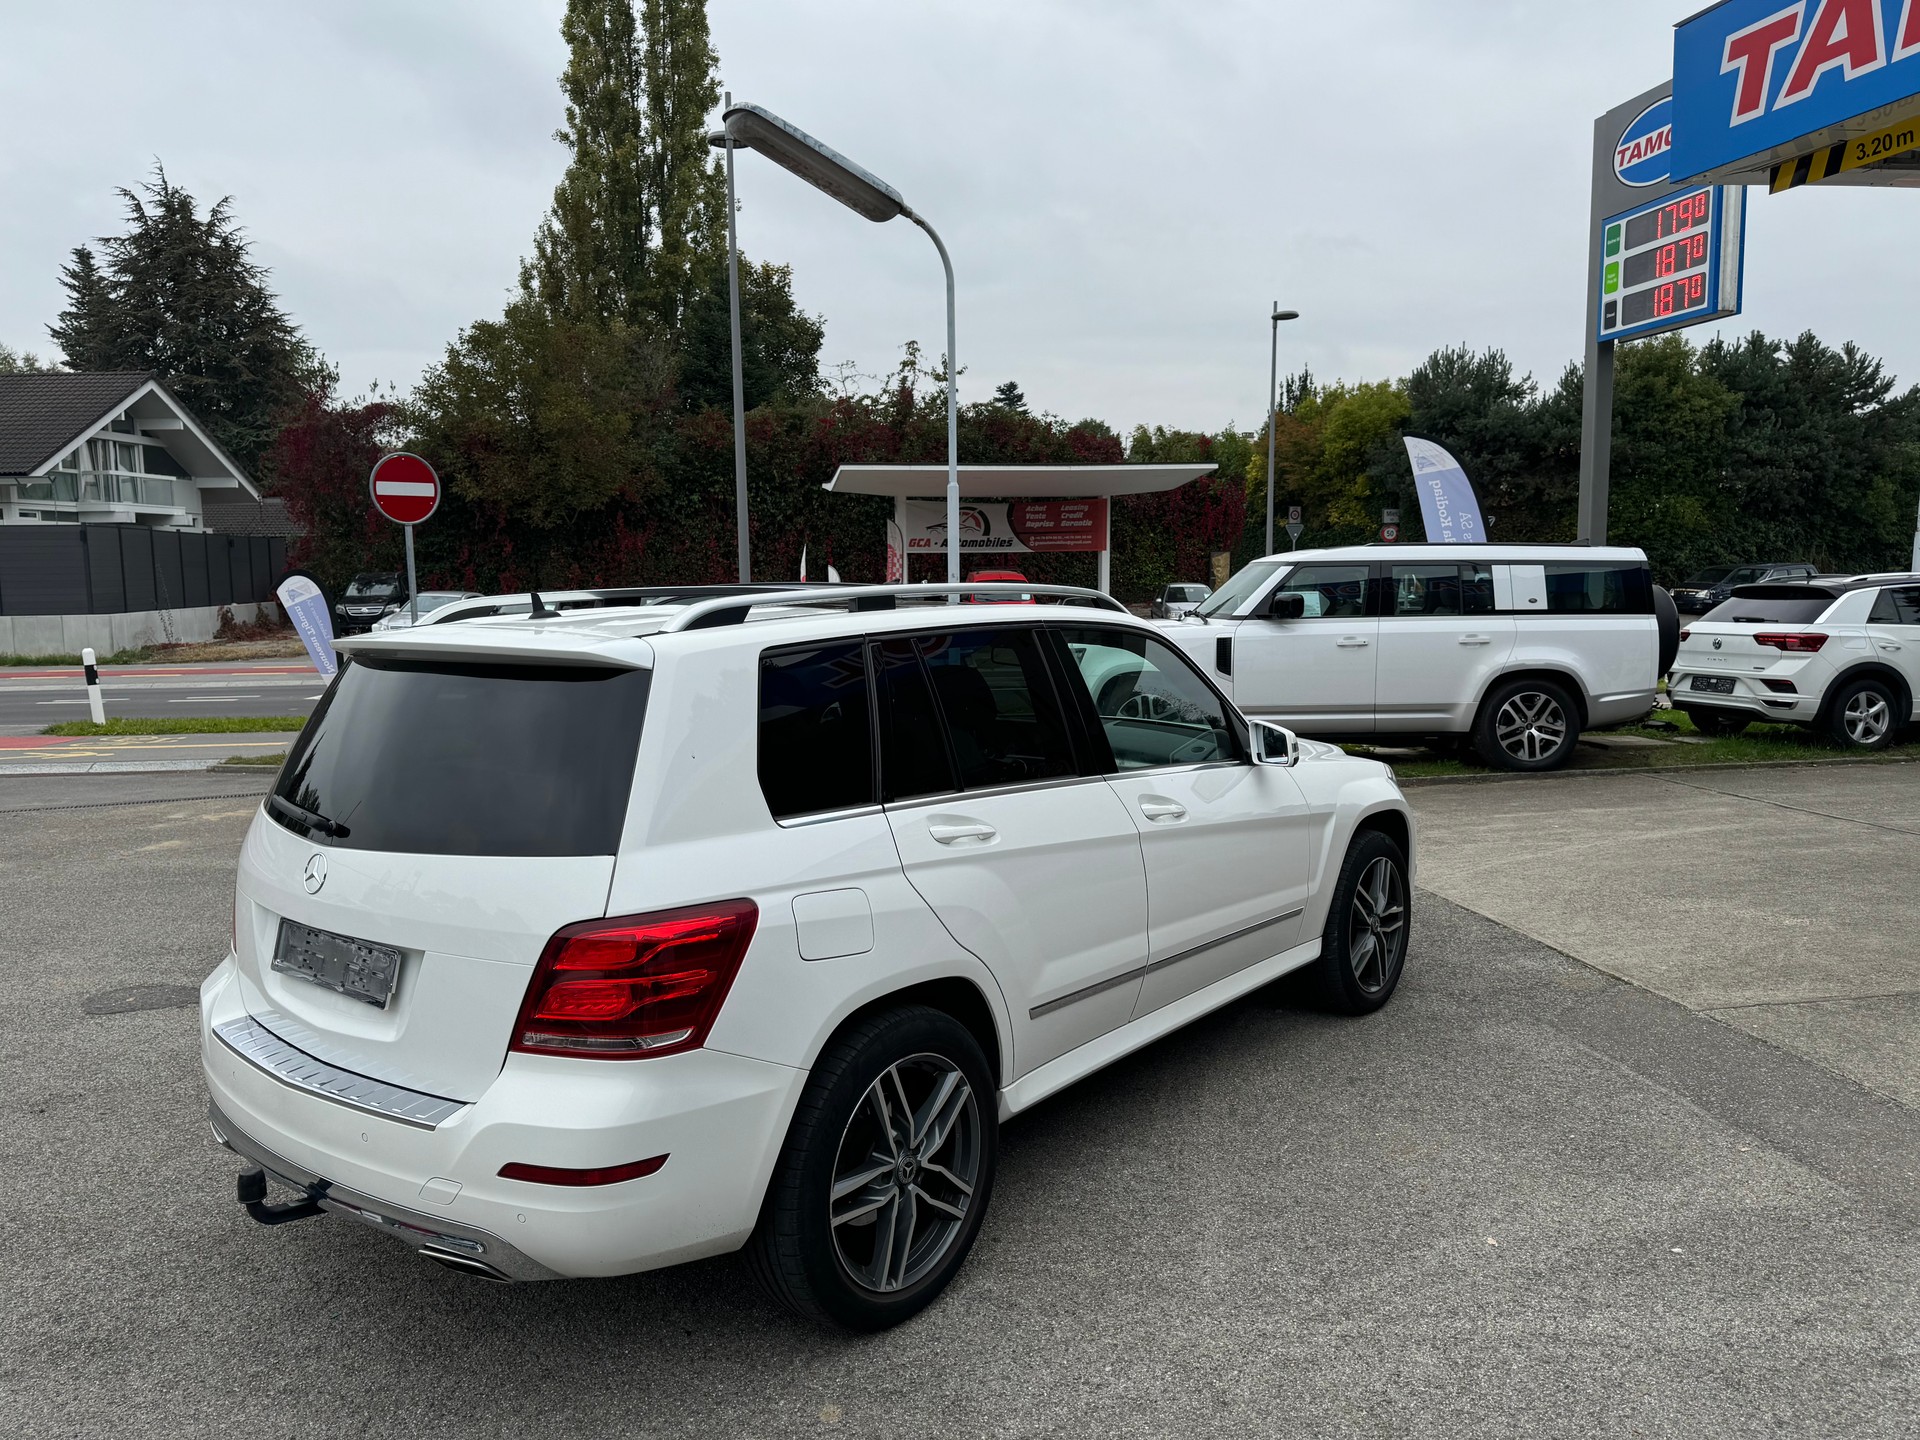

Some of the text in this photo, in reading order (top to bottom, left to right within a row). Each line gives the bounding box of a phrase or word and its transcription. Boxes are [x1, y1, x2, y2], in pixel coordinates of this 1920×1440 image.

[1856, 129, 1914, 161] 3.20 m
[1656, 234, 1704, 278] 1870
[1654, 274, 1702, 317] 1870
[908, 537, 1014, 548] GCA Aomobiles
